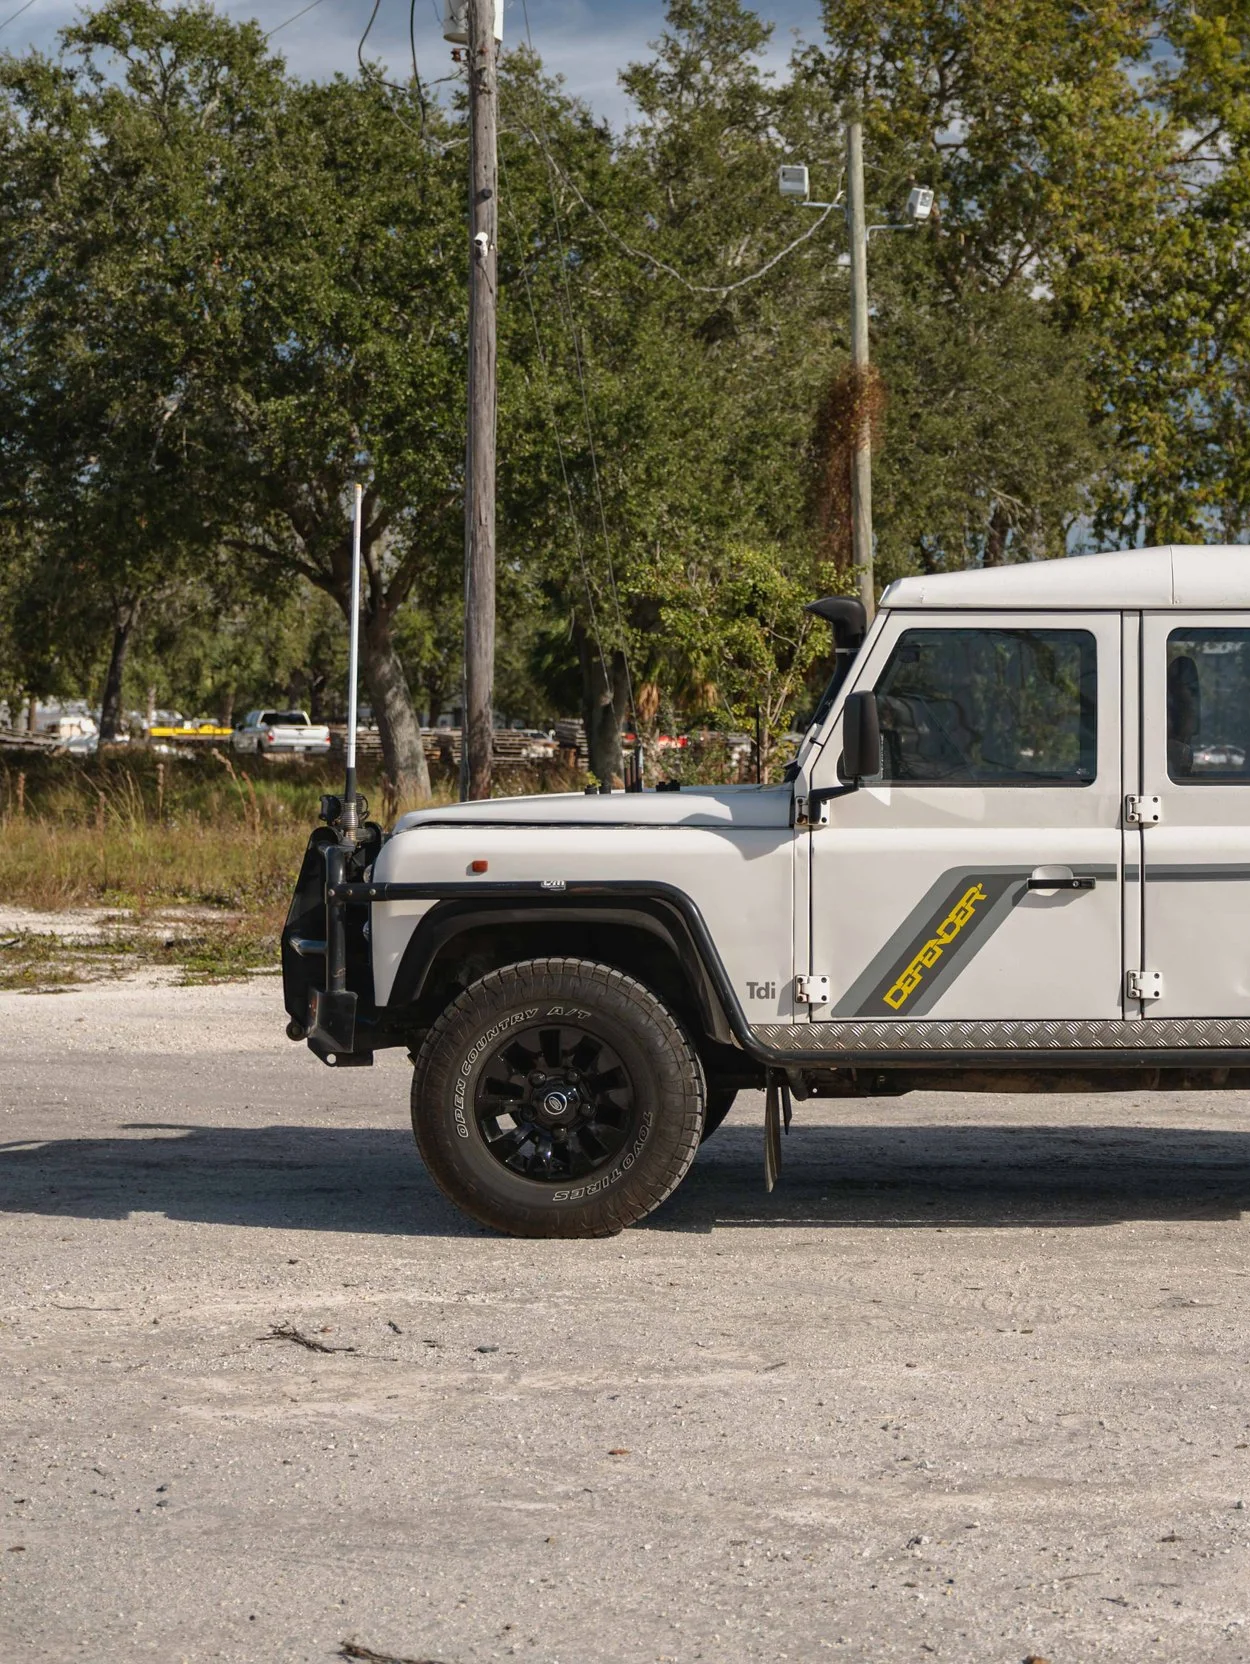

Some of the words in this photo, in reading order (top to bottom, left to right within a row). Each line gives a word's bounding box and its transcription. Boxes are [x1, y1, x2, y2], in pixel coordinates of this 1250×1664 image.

[883, 882, 988, 1010] DEFENDER
[746, 982, 776, 1000] Tdi
[453, 1078, 469, 1138] OPEN
[461, 1007, 539, 1075] COUNTRY
[547, 1006, 592, 1019] A/T
[621, 1111, 653, 1171] TOYO
[553, 1168, 622, 1201] TIRES
